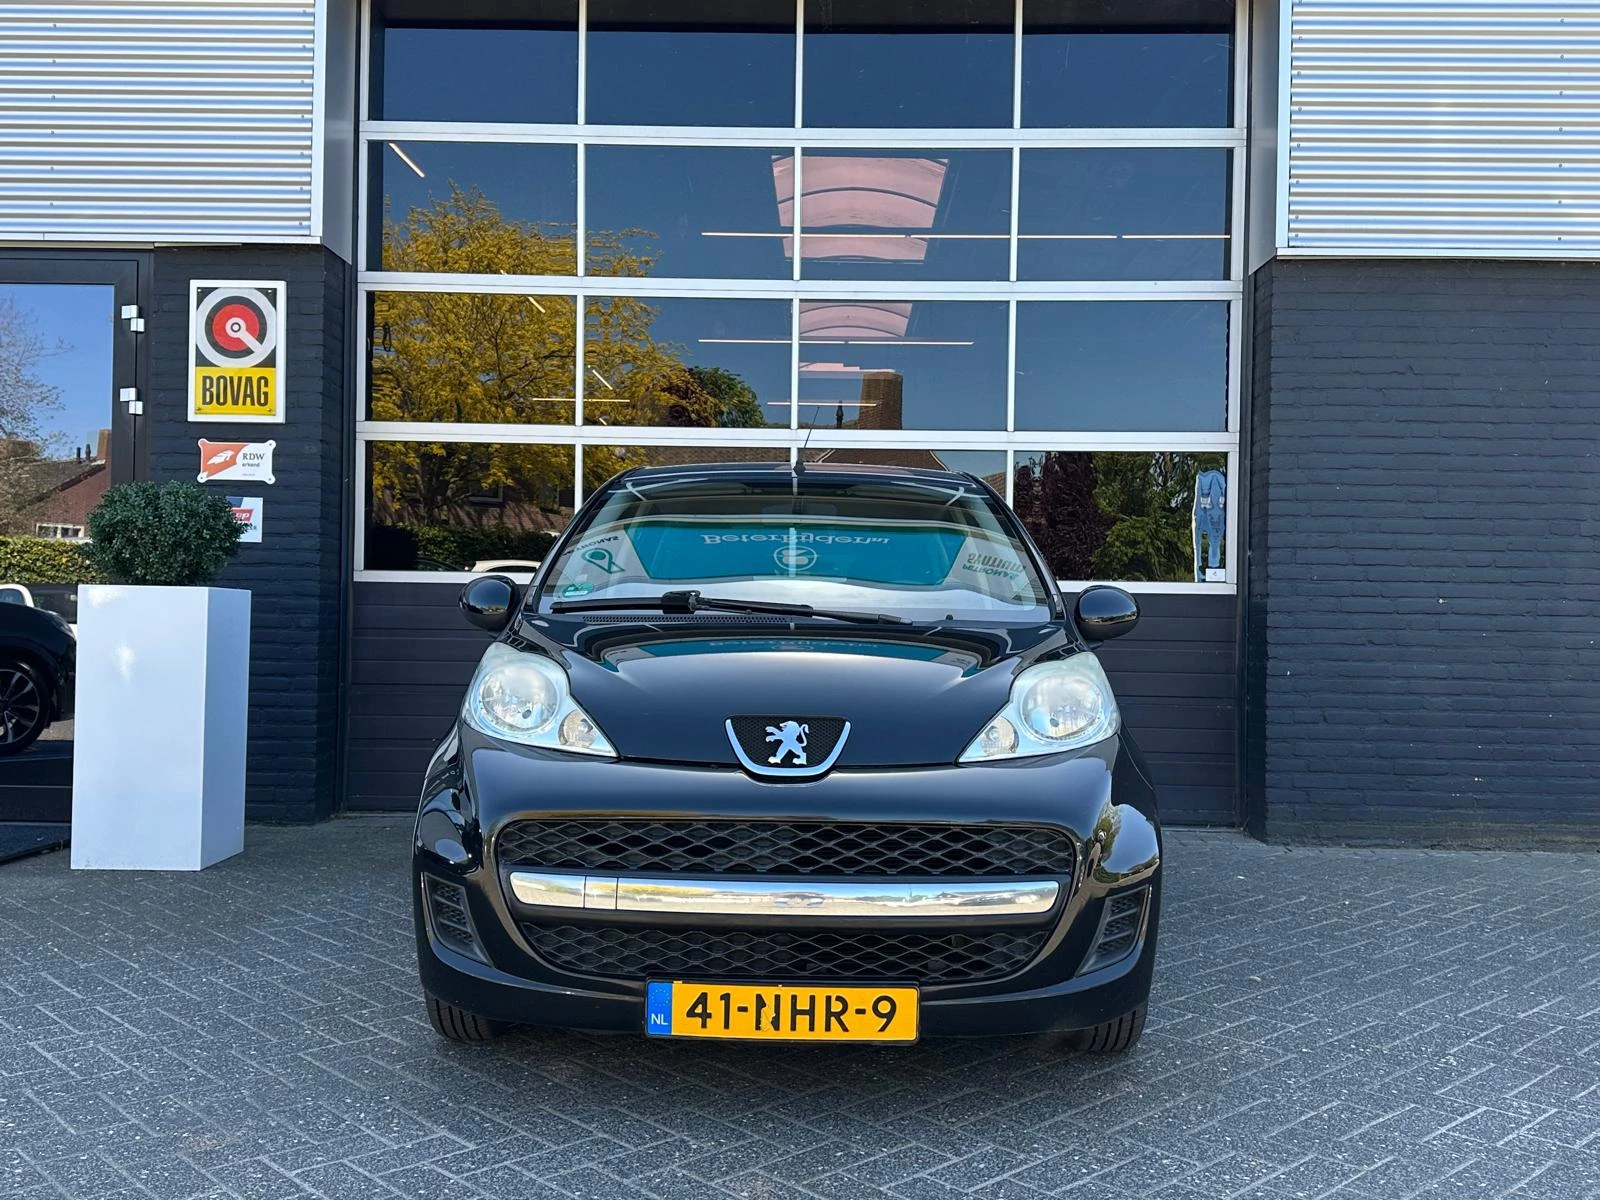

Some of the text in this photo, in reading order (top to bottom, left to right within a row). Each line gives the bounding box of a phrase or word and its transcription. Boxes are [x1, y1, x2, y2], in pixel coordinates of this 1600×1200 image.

[201, 375, 269, 407] BOVAG
[242, 452, 266, 461] RDW
[651, 1013, 669, 1025] NL
[685, 991, 898, 1033] 41-NHR-9
